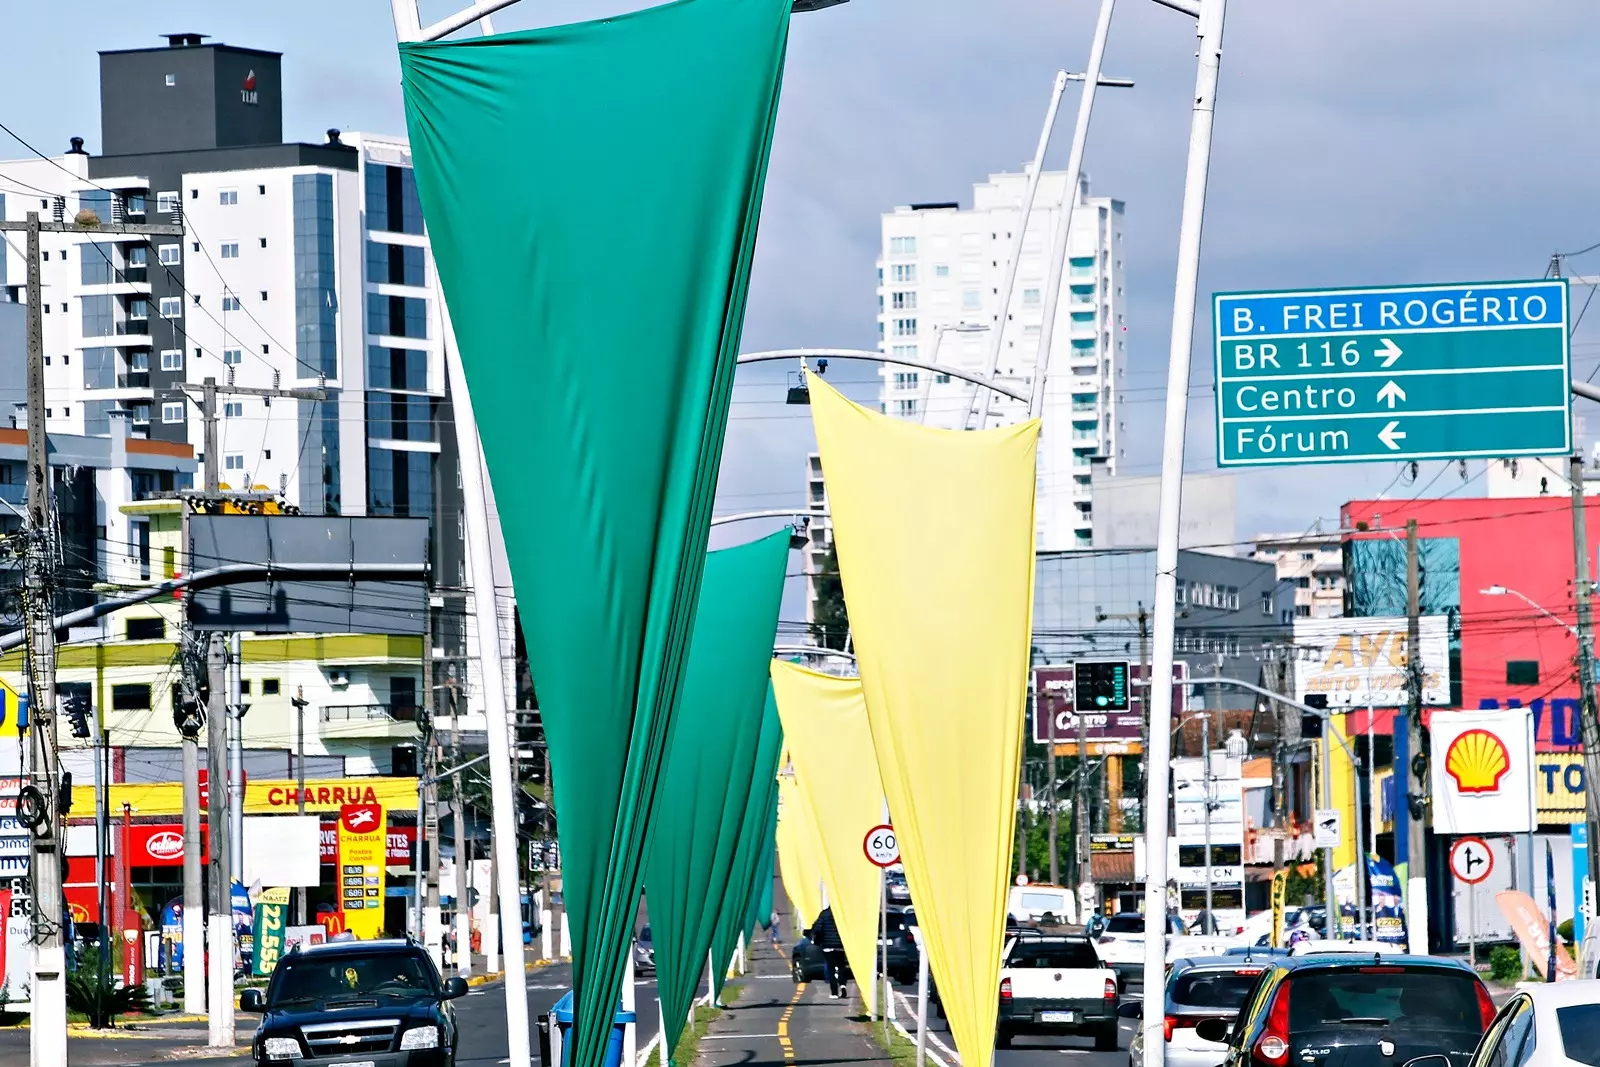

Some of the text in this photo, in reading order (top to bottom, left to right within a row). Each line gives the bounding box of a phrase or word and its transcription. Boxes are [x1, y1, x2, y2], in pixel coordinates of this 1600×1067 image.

[1233, 291, 1547, 332] B. FREI ROGÉRIO
[1234, 340, 1360, 370] BR 116
[1236, 383, 1356, 411] Centro
[1236, 425, 1349, 454] Fórum
[268, 786, 378, 806] CHARRUA
[340, 835, 381, 843] CHARRUA
[872, 835, 896, 849] 60
